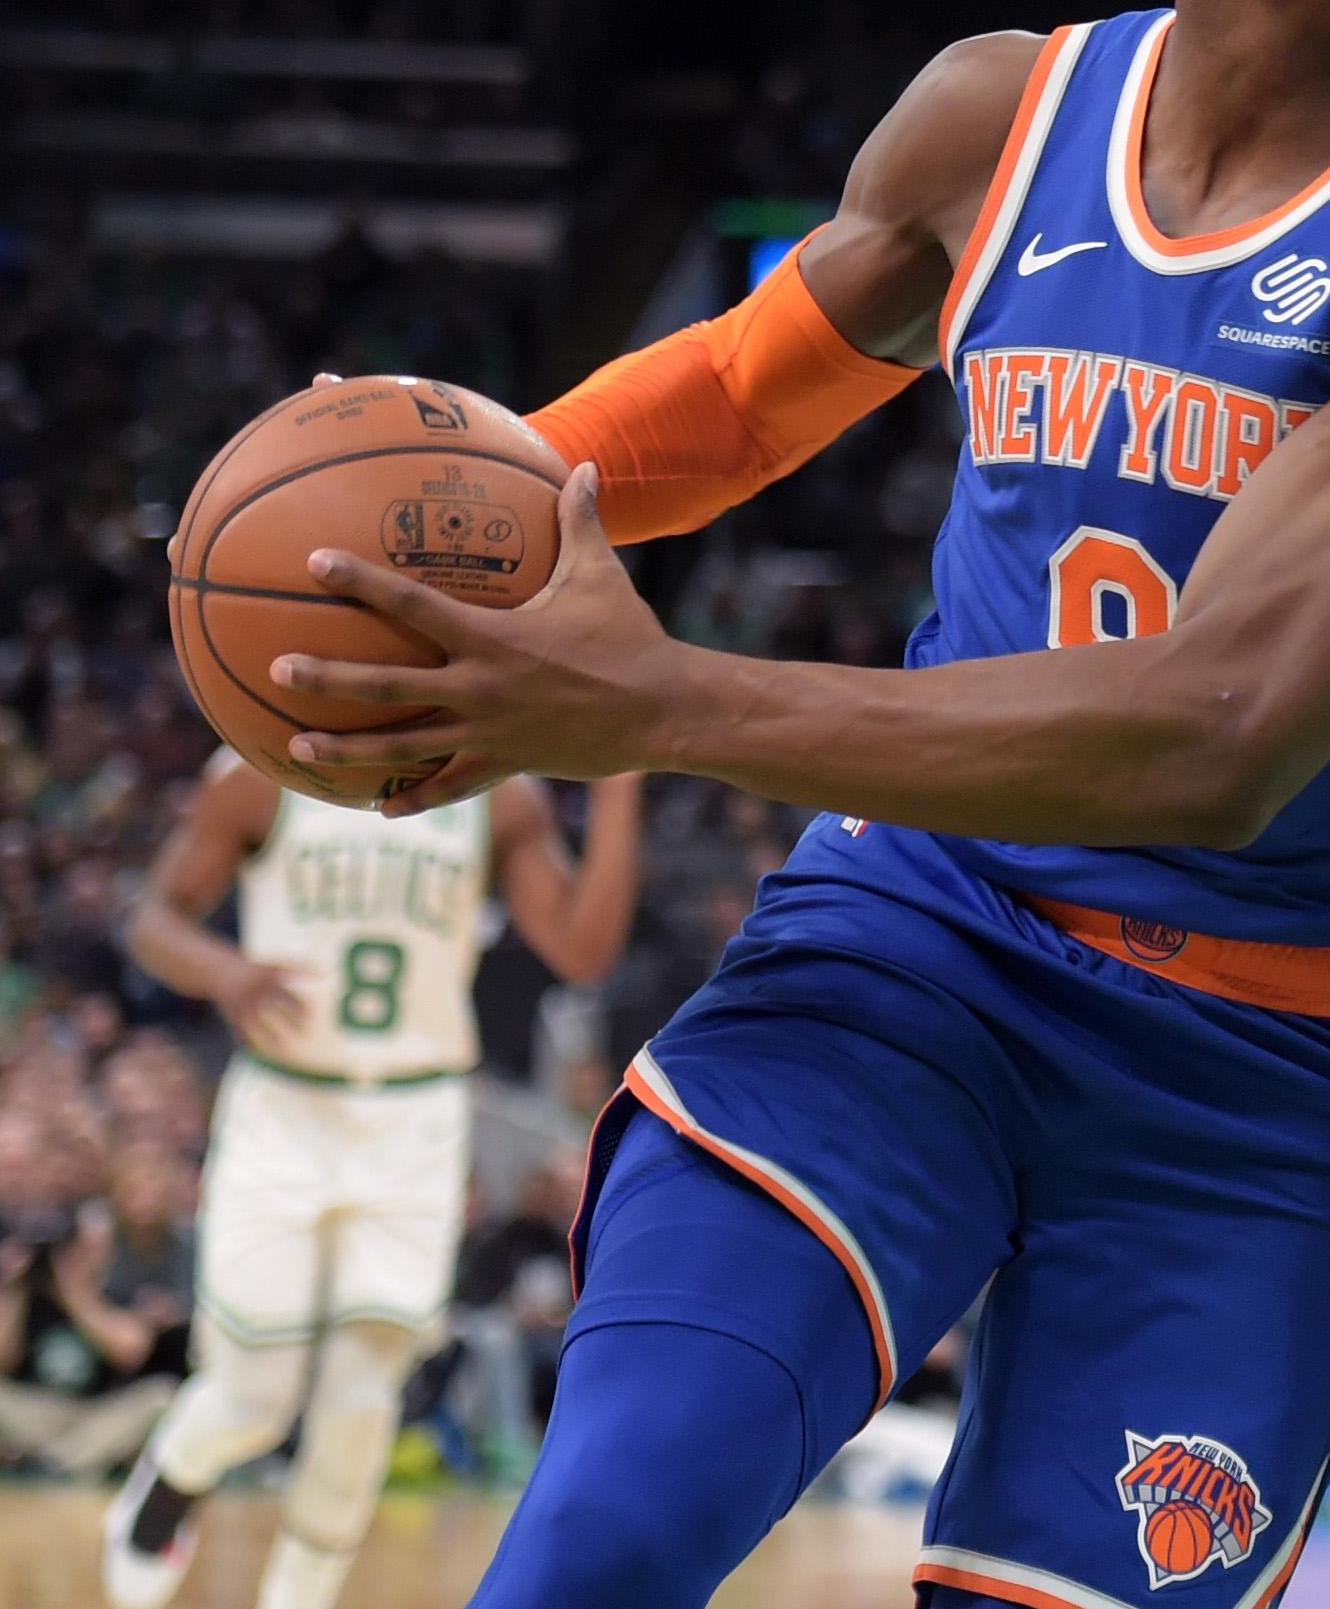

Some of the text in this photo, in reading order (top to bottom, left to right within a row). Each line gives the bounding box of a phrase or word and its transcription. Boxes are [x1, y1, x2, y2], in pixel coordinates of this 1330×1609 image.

[964, 348, 1124, 470] NEW
[338, 938, 406, 1033] 8
[1121, 1442, 1255, 1555] KNICKS
[1189, 1442, 1244, 1482] NEW YORK
